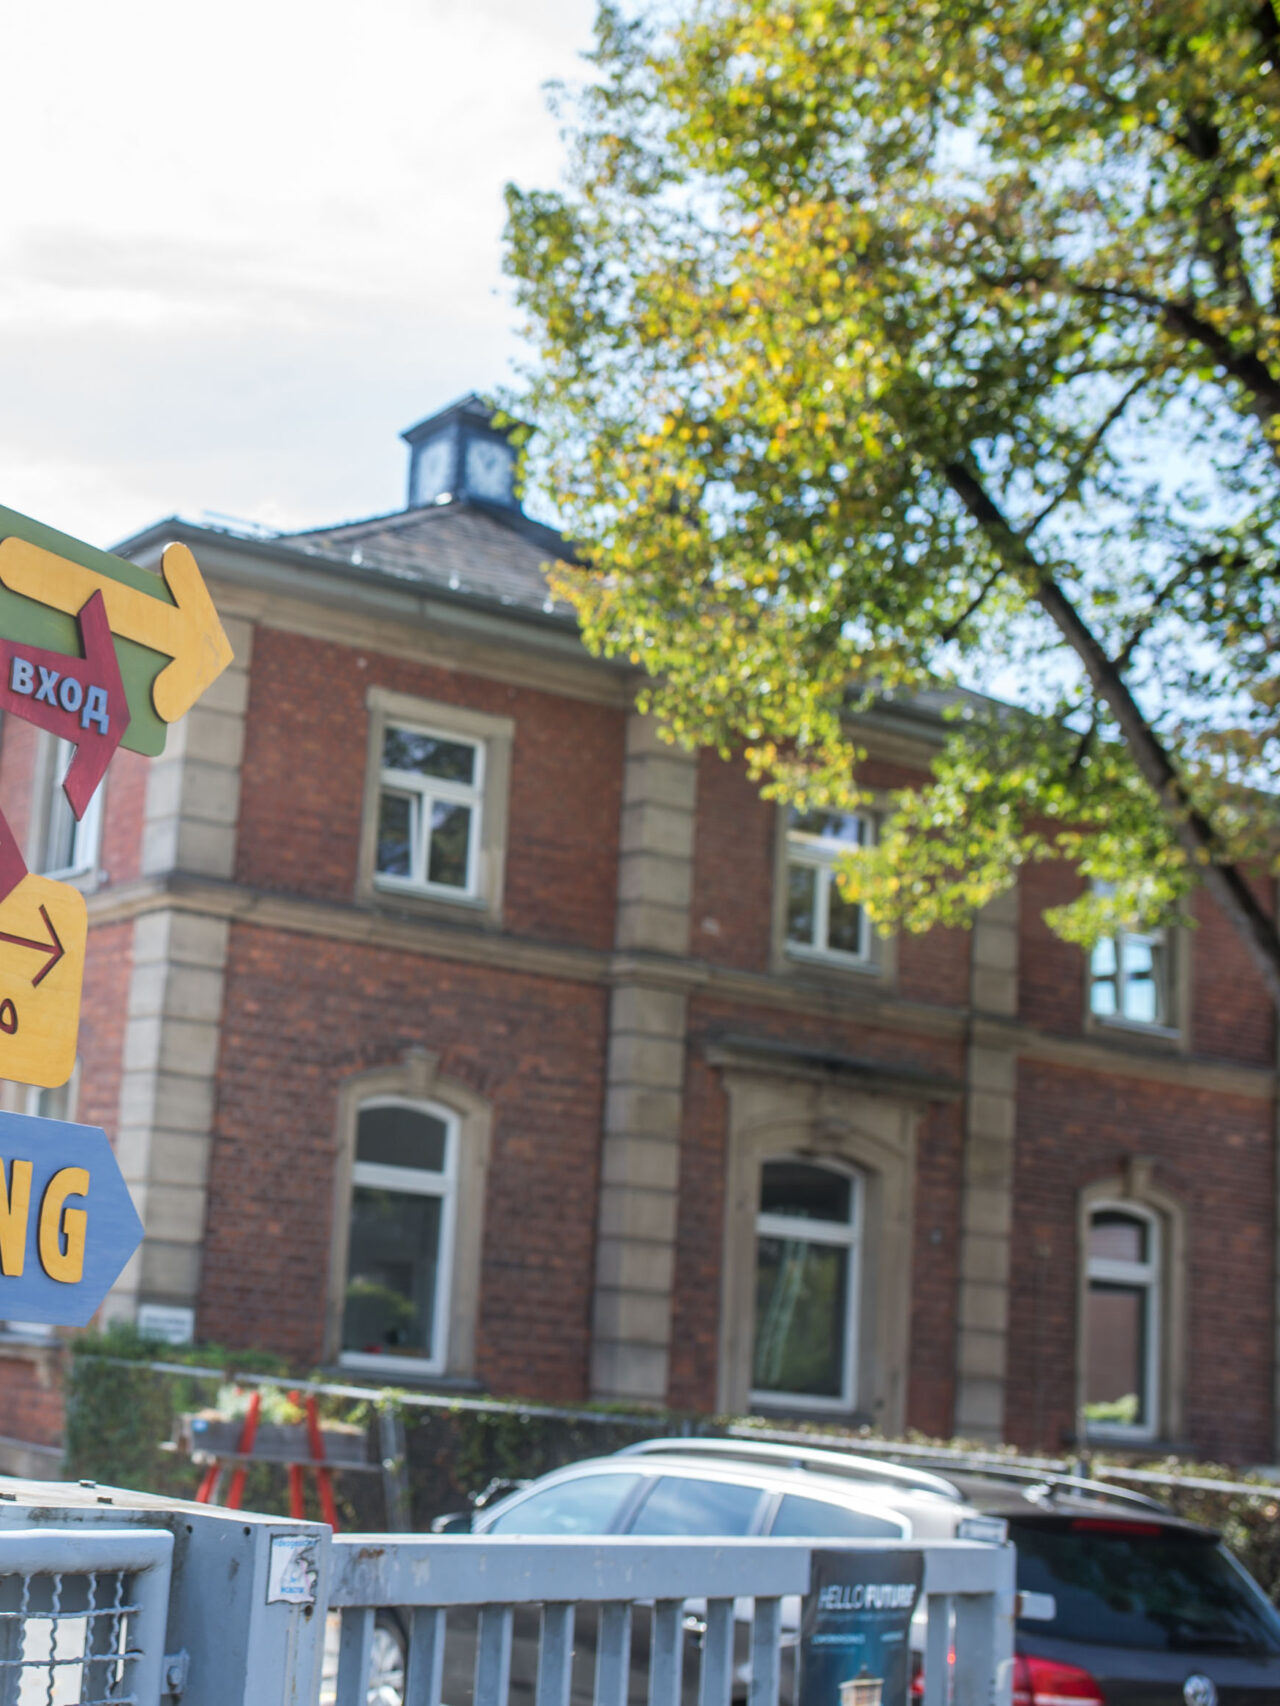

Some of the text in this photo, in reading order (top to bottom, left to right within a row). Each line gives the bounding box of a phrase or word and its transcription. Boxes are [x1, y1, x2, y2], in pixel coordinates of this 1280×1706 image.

[9, 655, 109, 736] ВХОД
[818, 1583, 917, 1609] HELLO FUTURE
